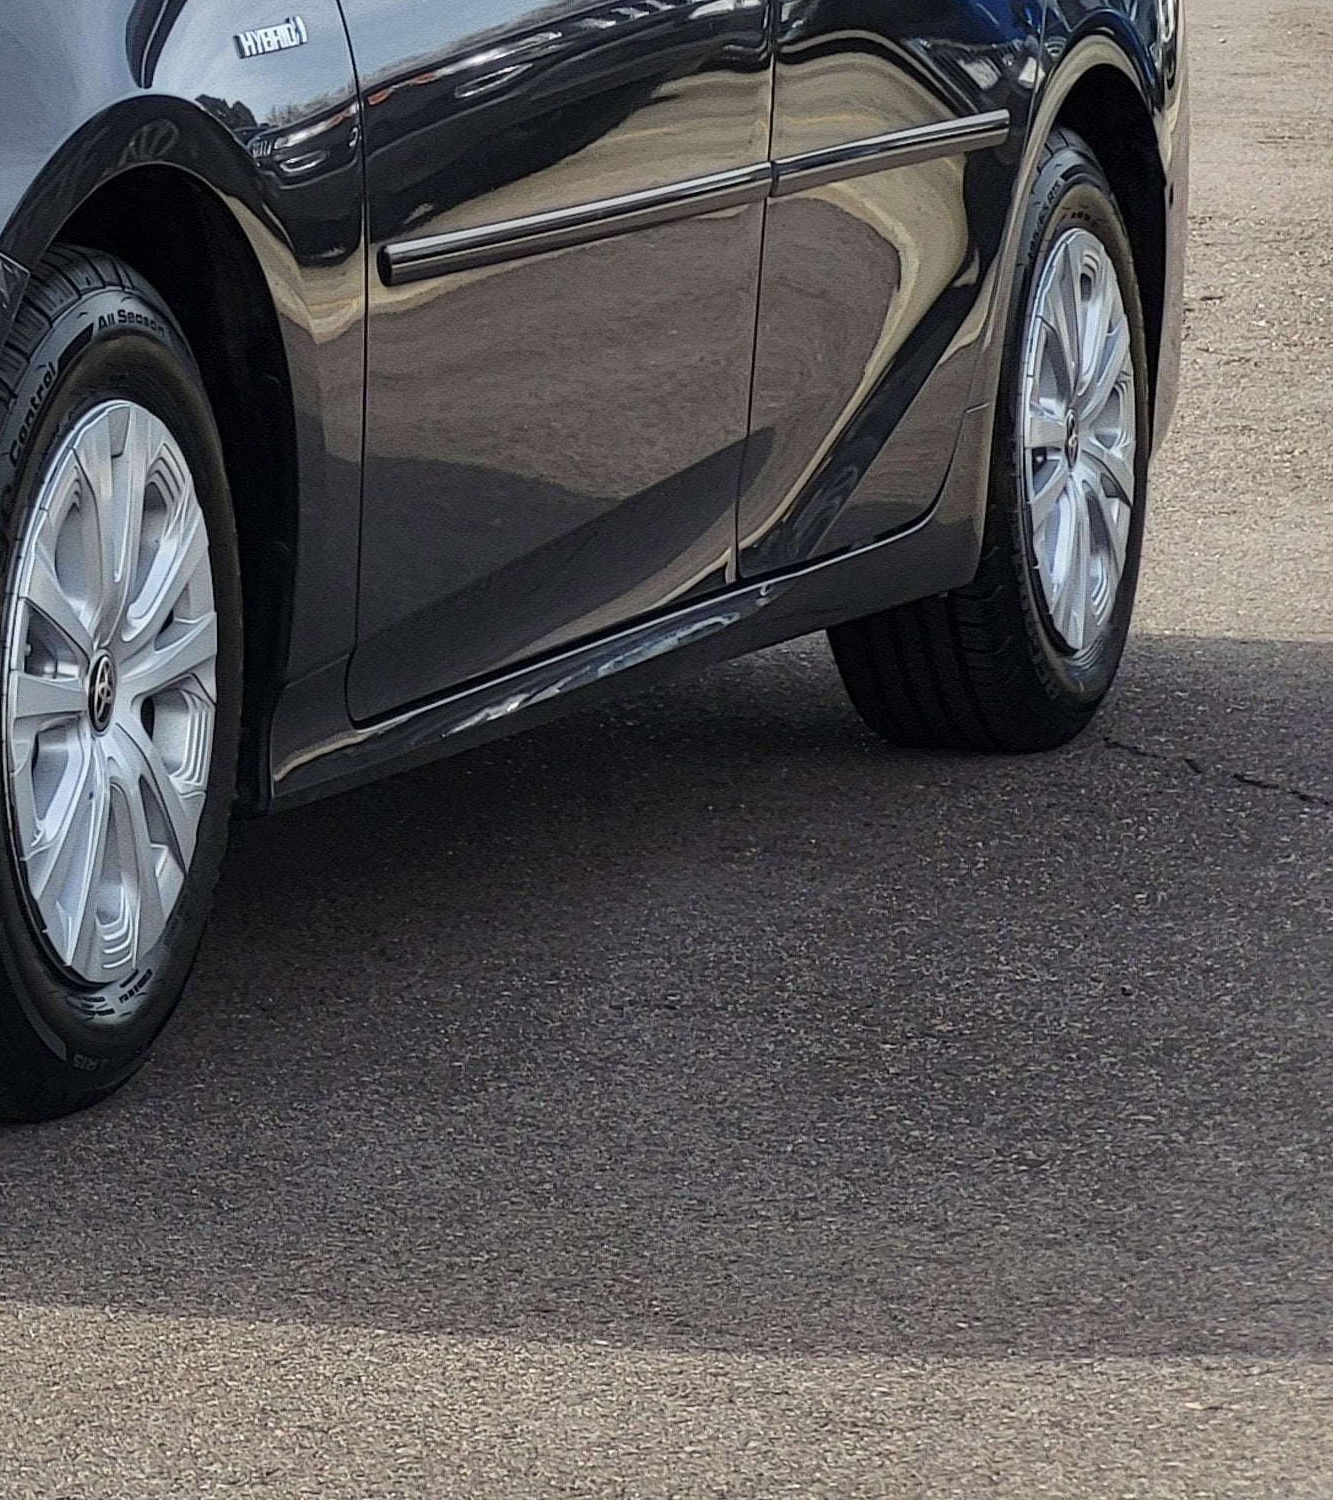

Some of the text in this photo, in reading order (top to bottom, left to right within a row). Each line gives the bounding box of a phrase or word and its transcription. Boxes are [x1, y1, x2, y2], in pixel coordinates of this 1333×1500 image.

[236, 22, 300, 58] HYBRID
[97, 309, 166, 338] All Season
[8, 361, 56, 468] Control
